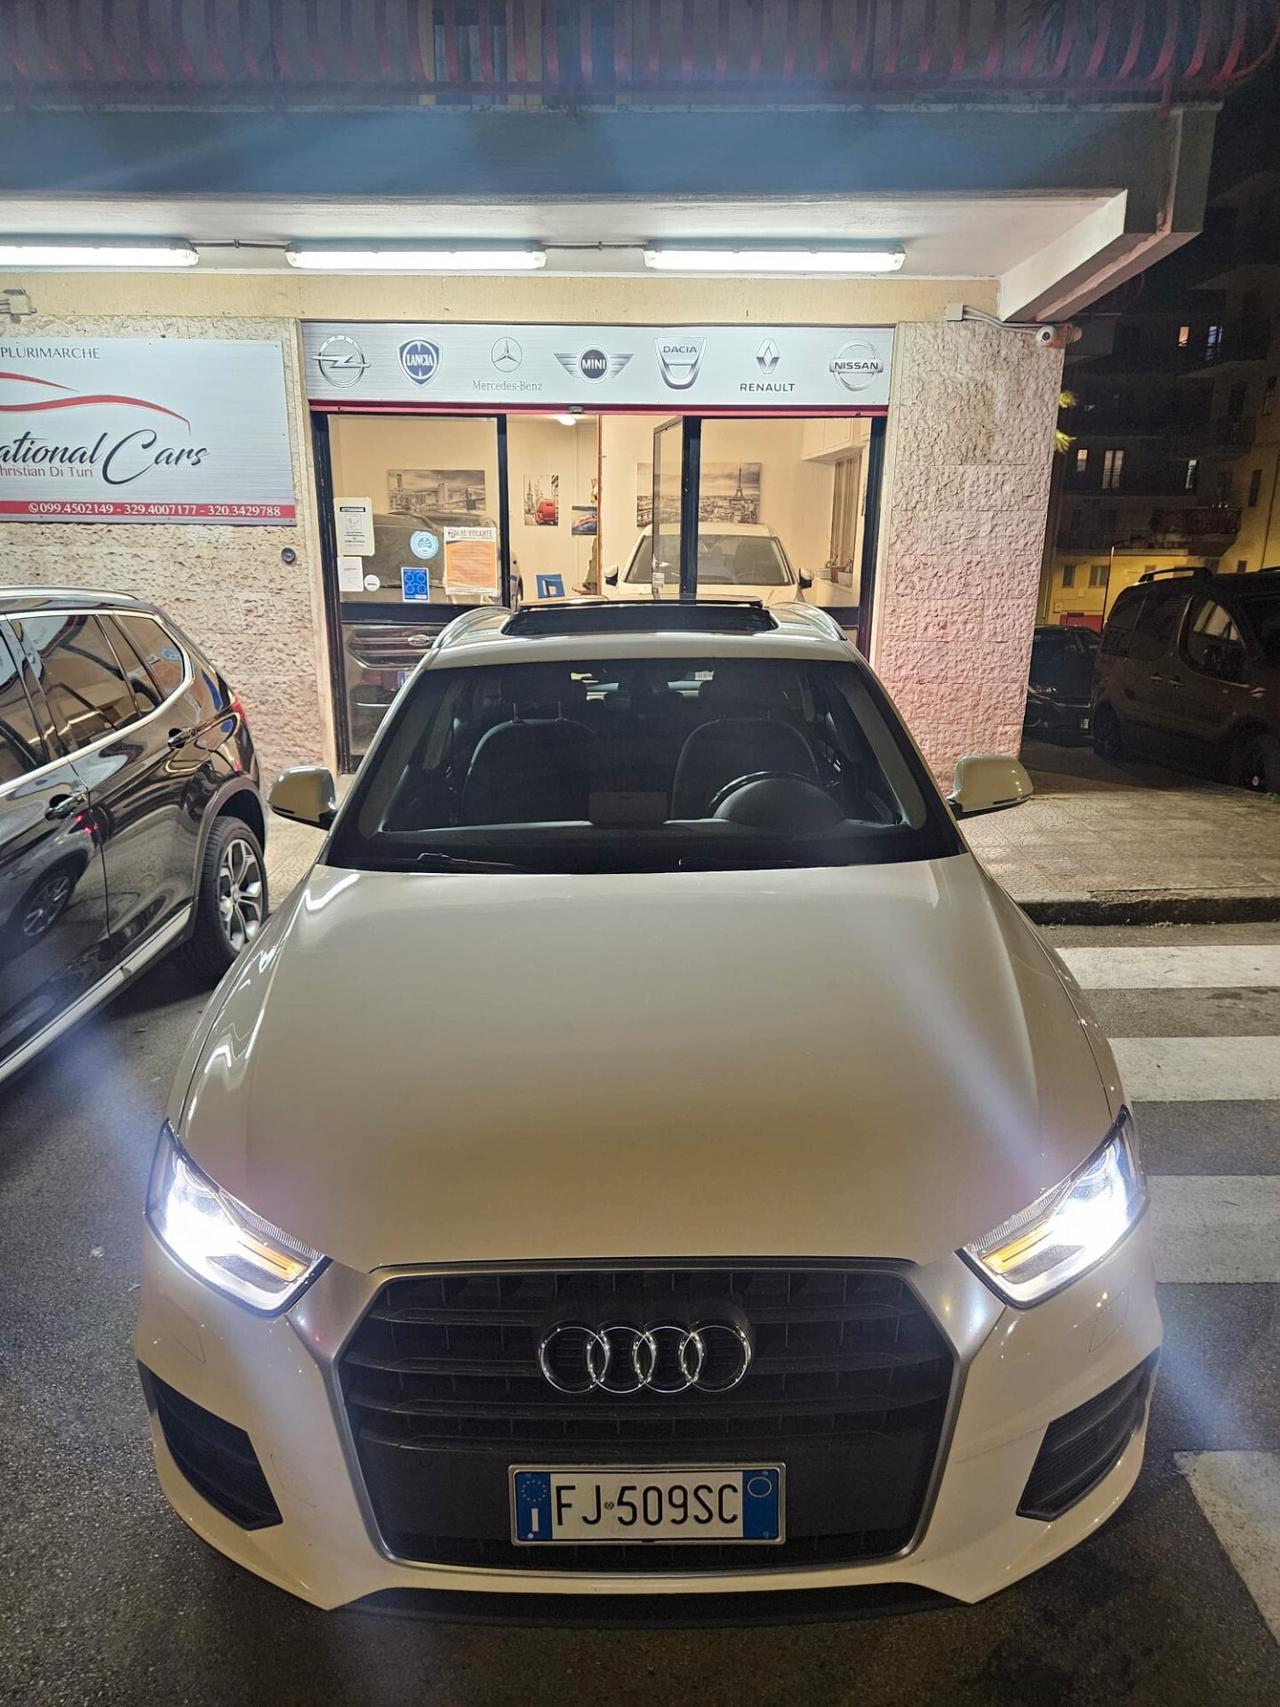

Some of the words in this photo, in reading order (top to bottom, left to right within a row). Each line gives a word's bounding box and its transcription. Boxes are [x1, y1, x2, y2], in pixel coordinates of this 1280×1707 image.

[0, 346, 101, 359] PLURIMARCHE
[663, 345, 697, 354] DACIA
[406, 353, 434, 366] LANCIA
[581, 358, 606, 370] MINI
[834, 360, 879, 371] NISSAN
[472, 380, 543, 391] Mercedes-Benz
[739, 383, 795, 392] RENAULT
[102, 428, 209, 485] Cars
[49, 465, 64, 477] Di
[67, 466, 94, 477] Turi
[40, 502, 113, 514] 099.4502149
[123, 503, 197, 515] 329.4007177
[208, 504, 281, 517] 320.3429788
